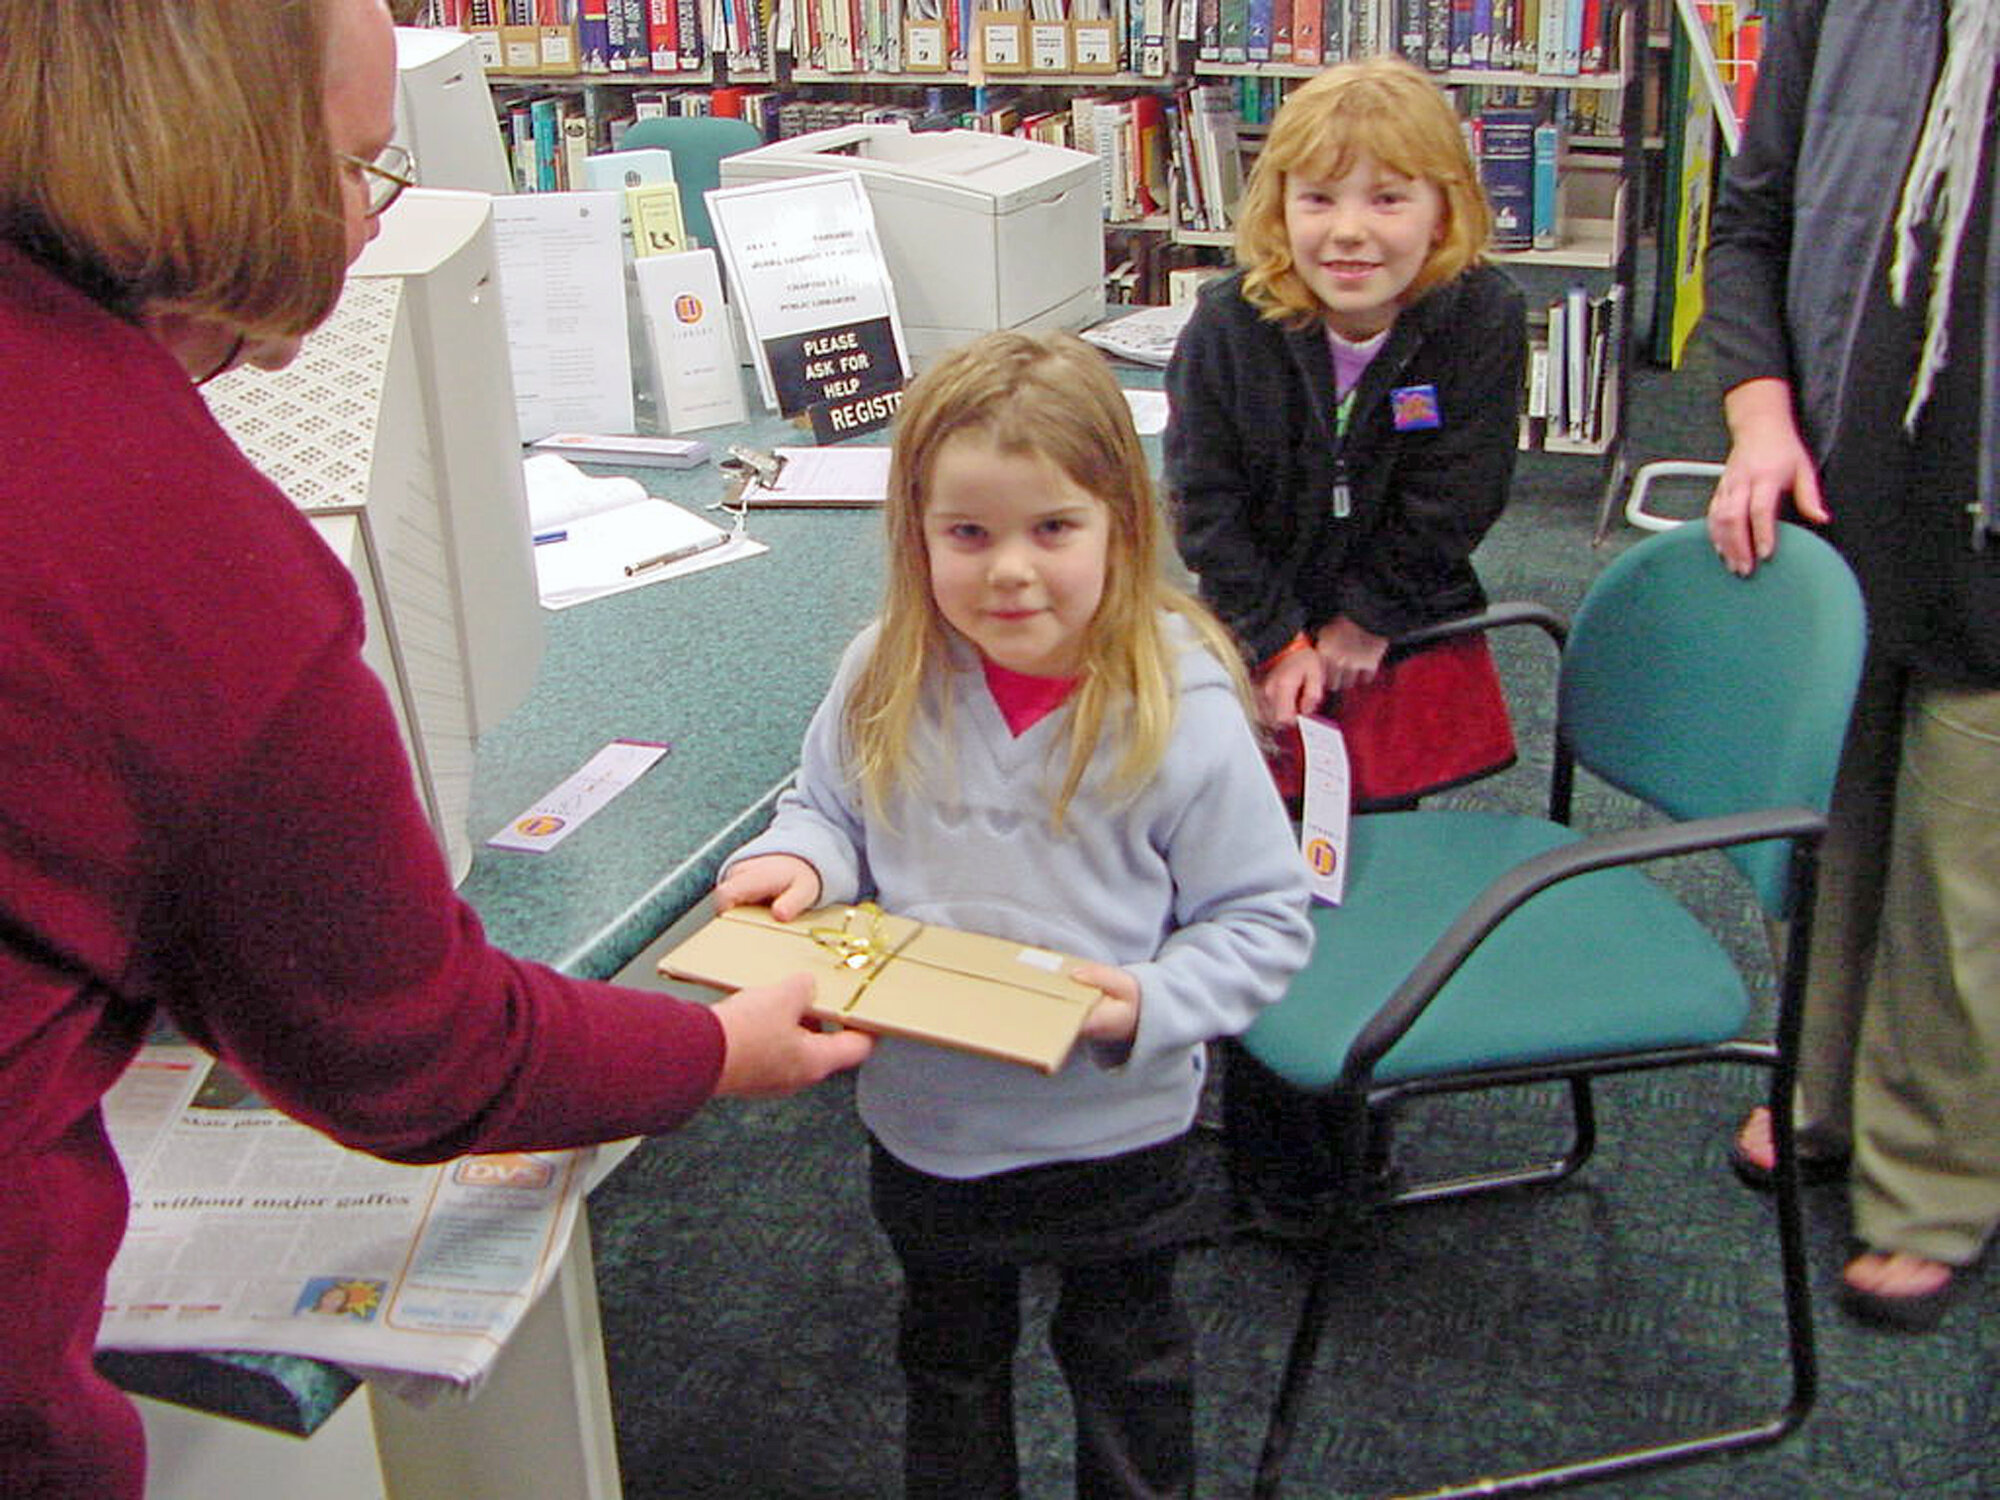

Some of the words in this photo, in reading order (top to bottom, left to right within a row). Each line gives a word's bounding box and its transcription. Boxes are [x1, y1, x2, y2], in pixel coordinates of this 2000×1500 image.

[803, 332, 859, 357] PLEASE
[805, 360, 835, 381] ASK
[839, 352, 870, 373] FOR
[822, 377, 861, 399] HELP
[152, 1195, 245, 1210] without
[251, 1194, 327, 1210] major
[336, 1192, 410, 1209] gaffes
